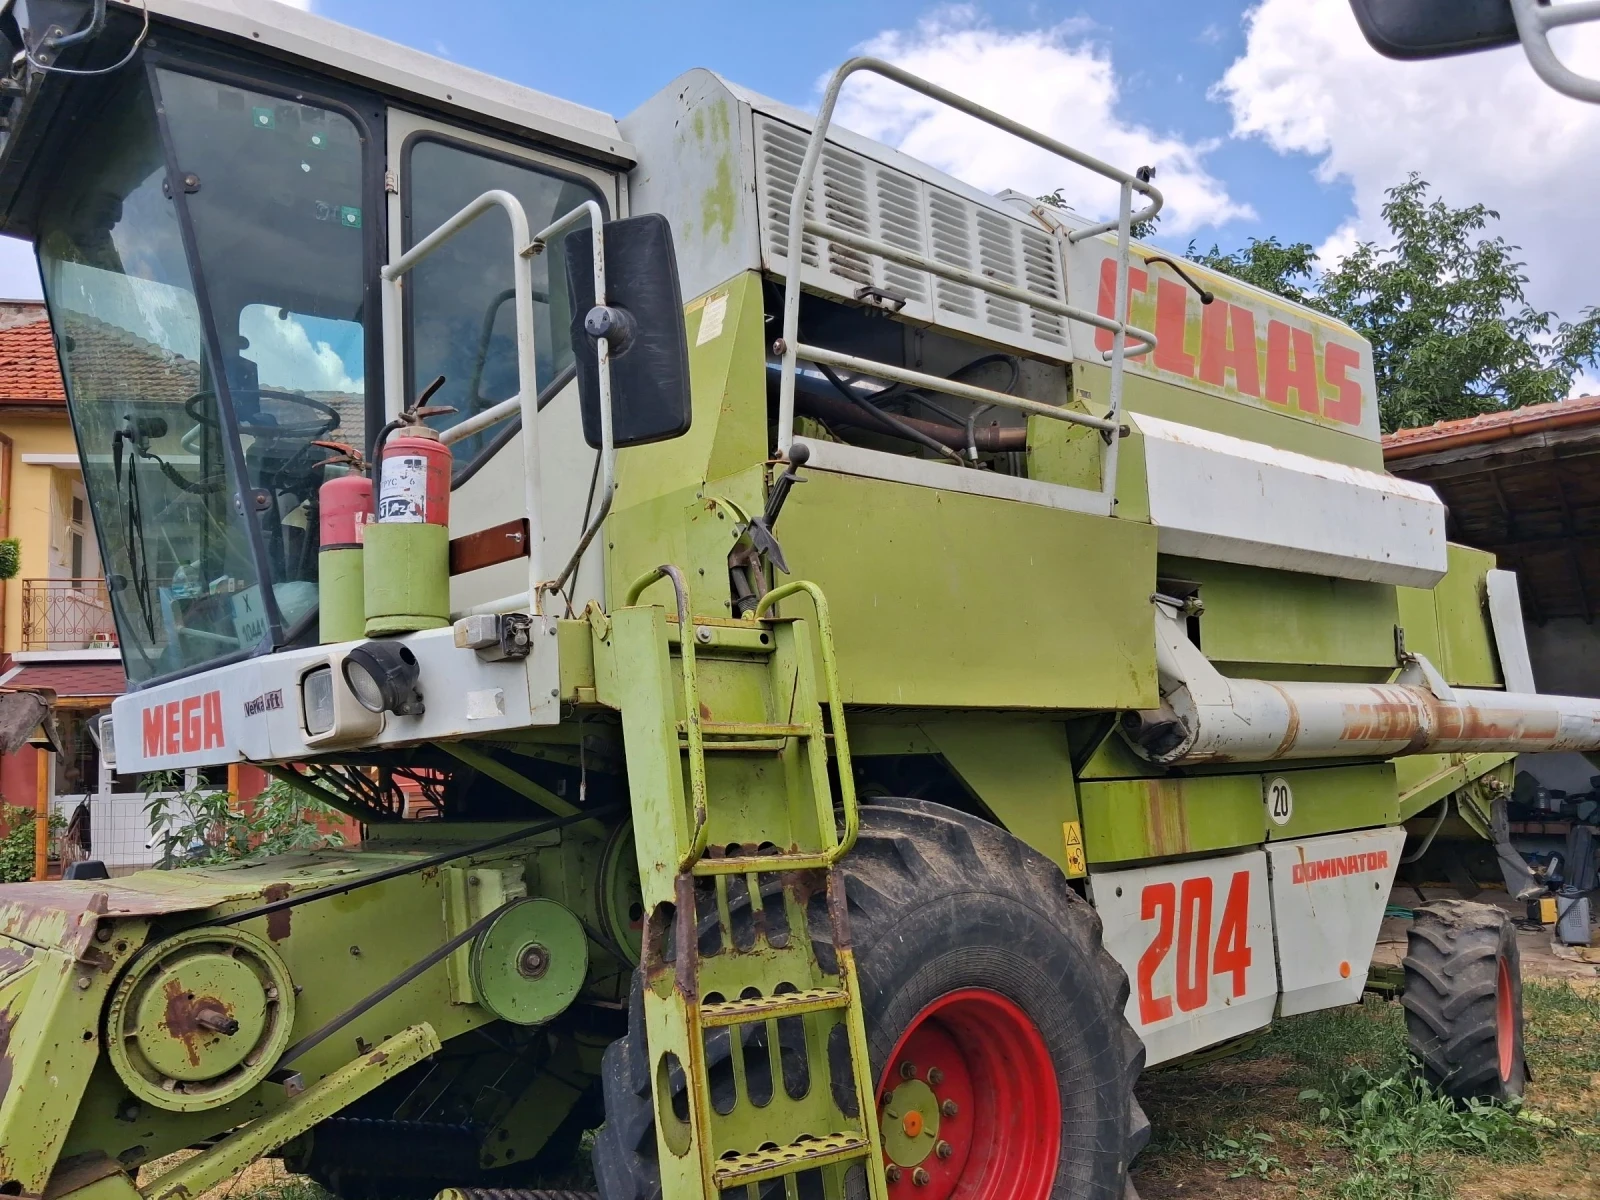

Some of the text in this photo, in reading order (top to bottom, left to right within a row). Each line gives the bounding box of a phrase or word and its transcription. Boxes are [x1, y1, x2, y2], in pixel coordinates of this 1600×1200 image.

[1094, 257, 1362, 427] CLAAS
[143, 690, 225, 758] MEGA
[1272, 785, 1289, 817] 20
[1292, 850, 1388, 885] DOMINATOR
[1137, 870, 1252, 1026] 204
